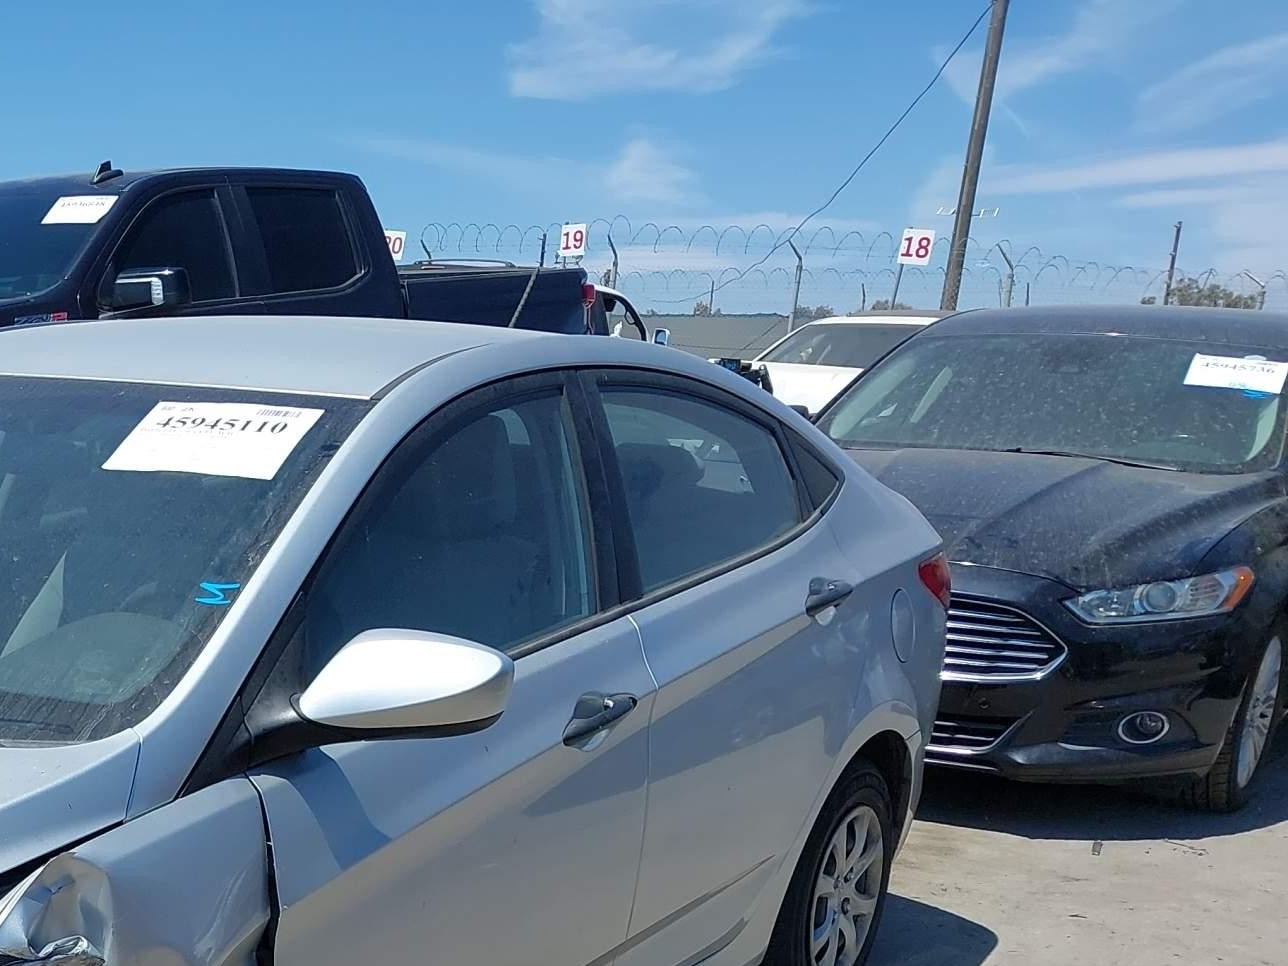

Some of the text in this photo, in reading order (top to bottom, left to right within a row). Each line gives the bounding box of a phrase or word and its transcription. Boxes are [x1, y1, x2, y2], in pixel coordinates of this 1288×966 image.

[562, 230, 584, 251] 19
[900, 236, 931, 259] 18
[156, 416, 288, 434] 45945110
